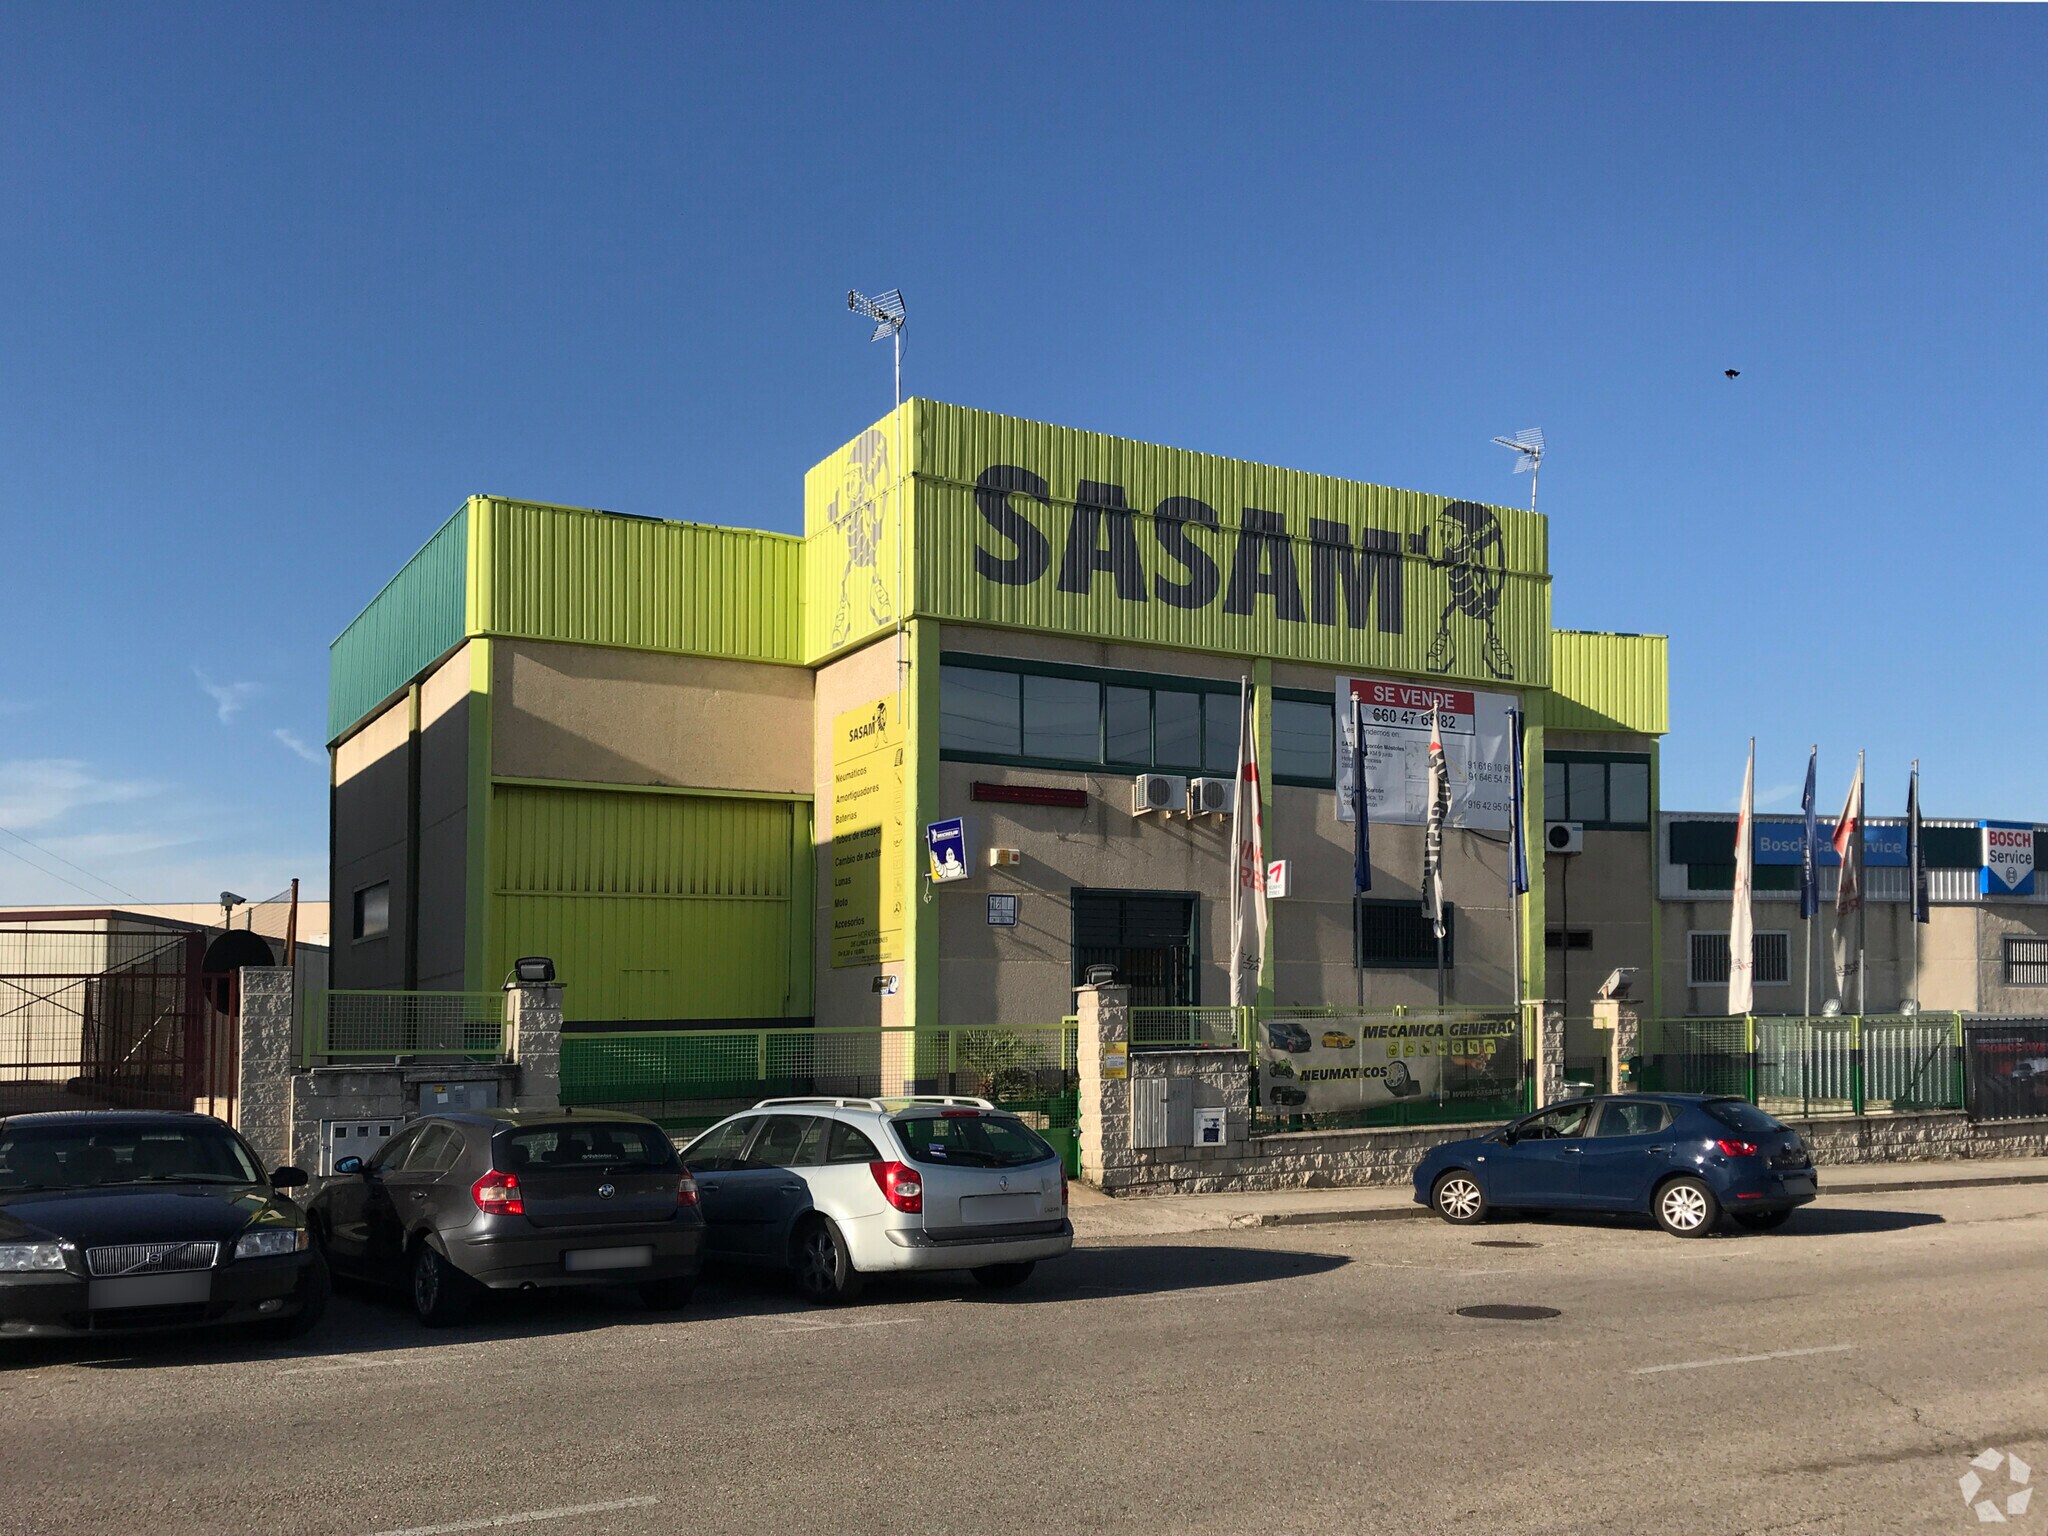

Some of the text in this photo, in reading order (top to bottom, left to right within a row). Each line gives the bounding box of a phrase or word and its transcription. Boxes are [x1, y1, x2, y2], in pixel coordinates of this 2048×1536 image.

[975, 465, 1403, 634] SASAM
[1373, 685, 1455, 710] SE VENDE
[1401, 711, 1417, 725] 47
[1441, 715, 1456, 729] 82
[849, 721, 875, 742] SASAM
[1468, 760, 1476, 770] 91
[1479, 761, 1492, 771] 616
[1469, 772, 1477, 781] 91
[836, 784, 879, 804] Amortiguadores
[1468, 800, 1481, 810] 916
[1482, 801, 1491, 811] 42
[1493, 802, 1502, 812] 95
[835, 825, 881, 844] Tubos de escape
[1989, 831, 2031, 847] BOSCH
[1760, 837, 1902, 854] Bosch Ca rvice
[835, 849, 881, 867] Cambio de aceite
[1989, 849, 2032, 865] Service
[834, 876, 851, 887] Lunas
[834, 898, 848, 908] Moto
[834, 917, 865, 929] Accesorios
[1363, 1019, 1516, 1038] MECANICA GENERAL
